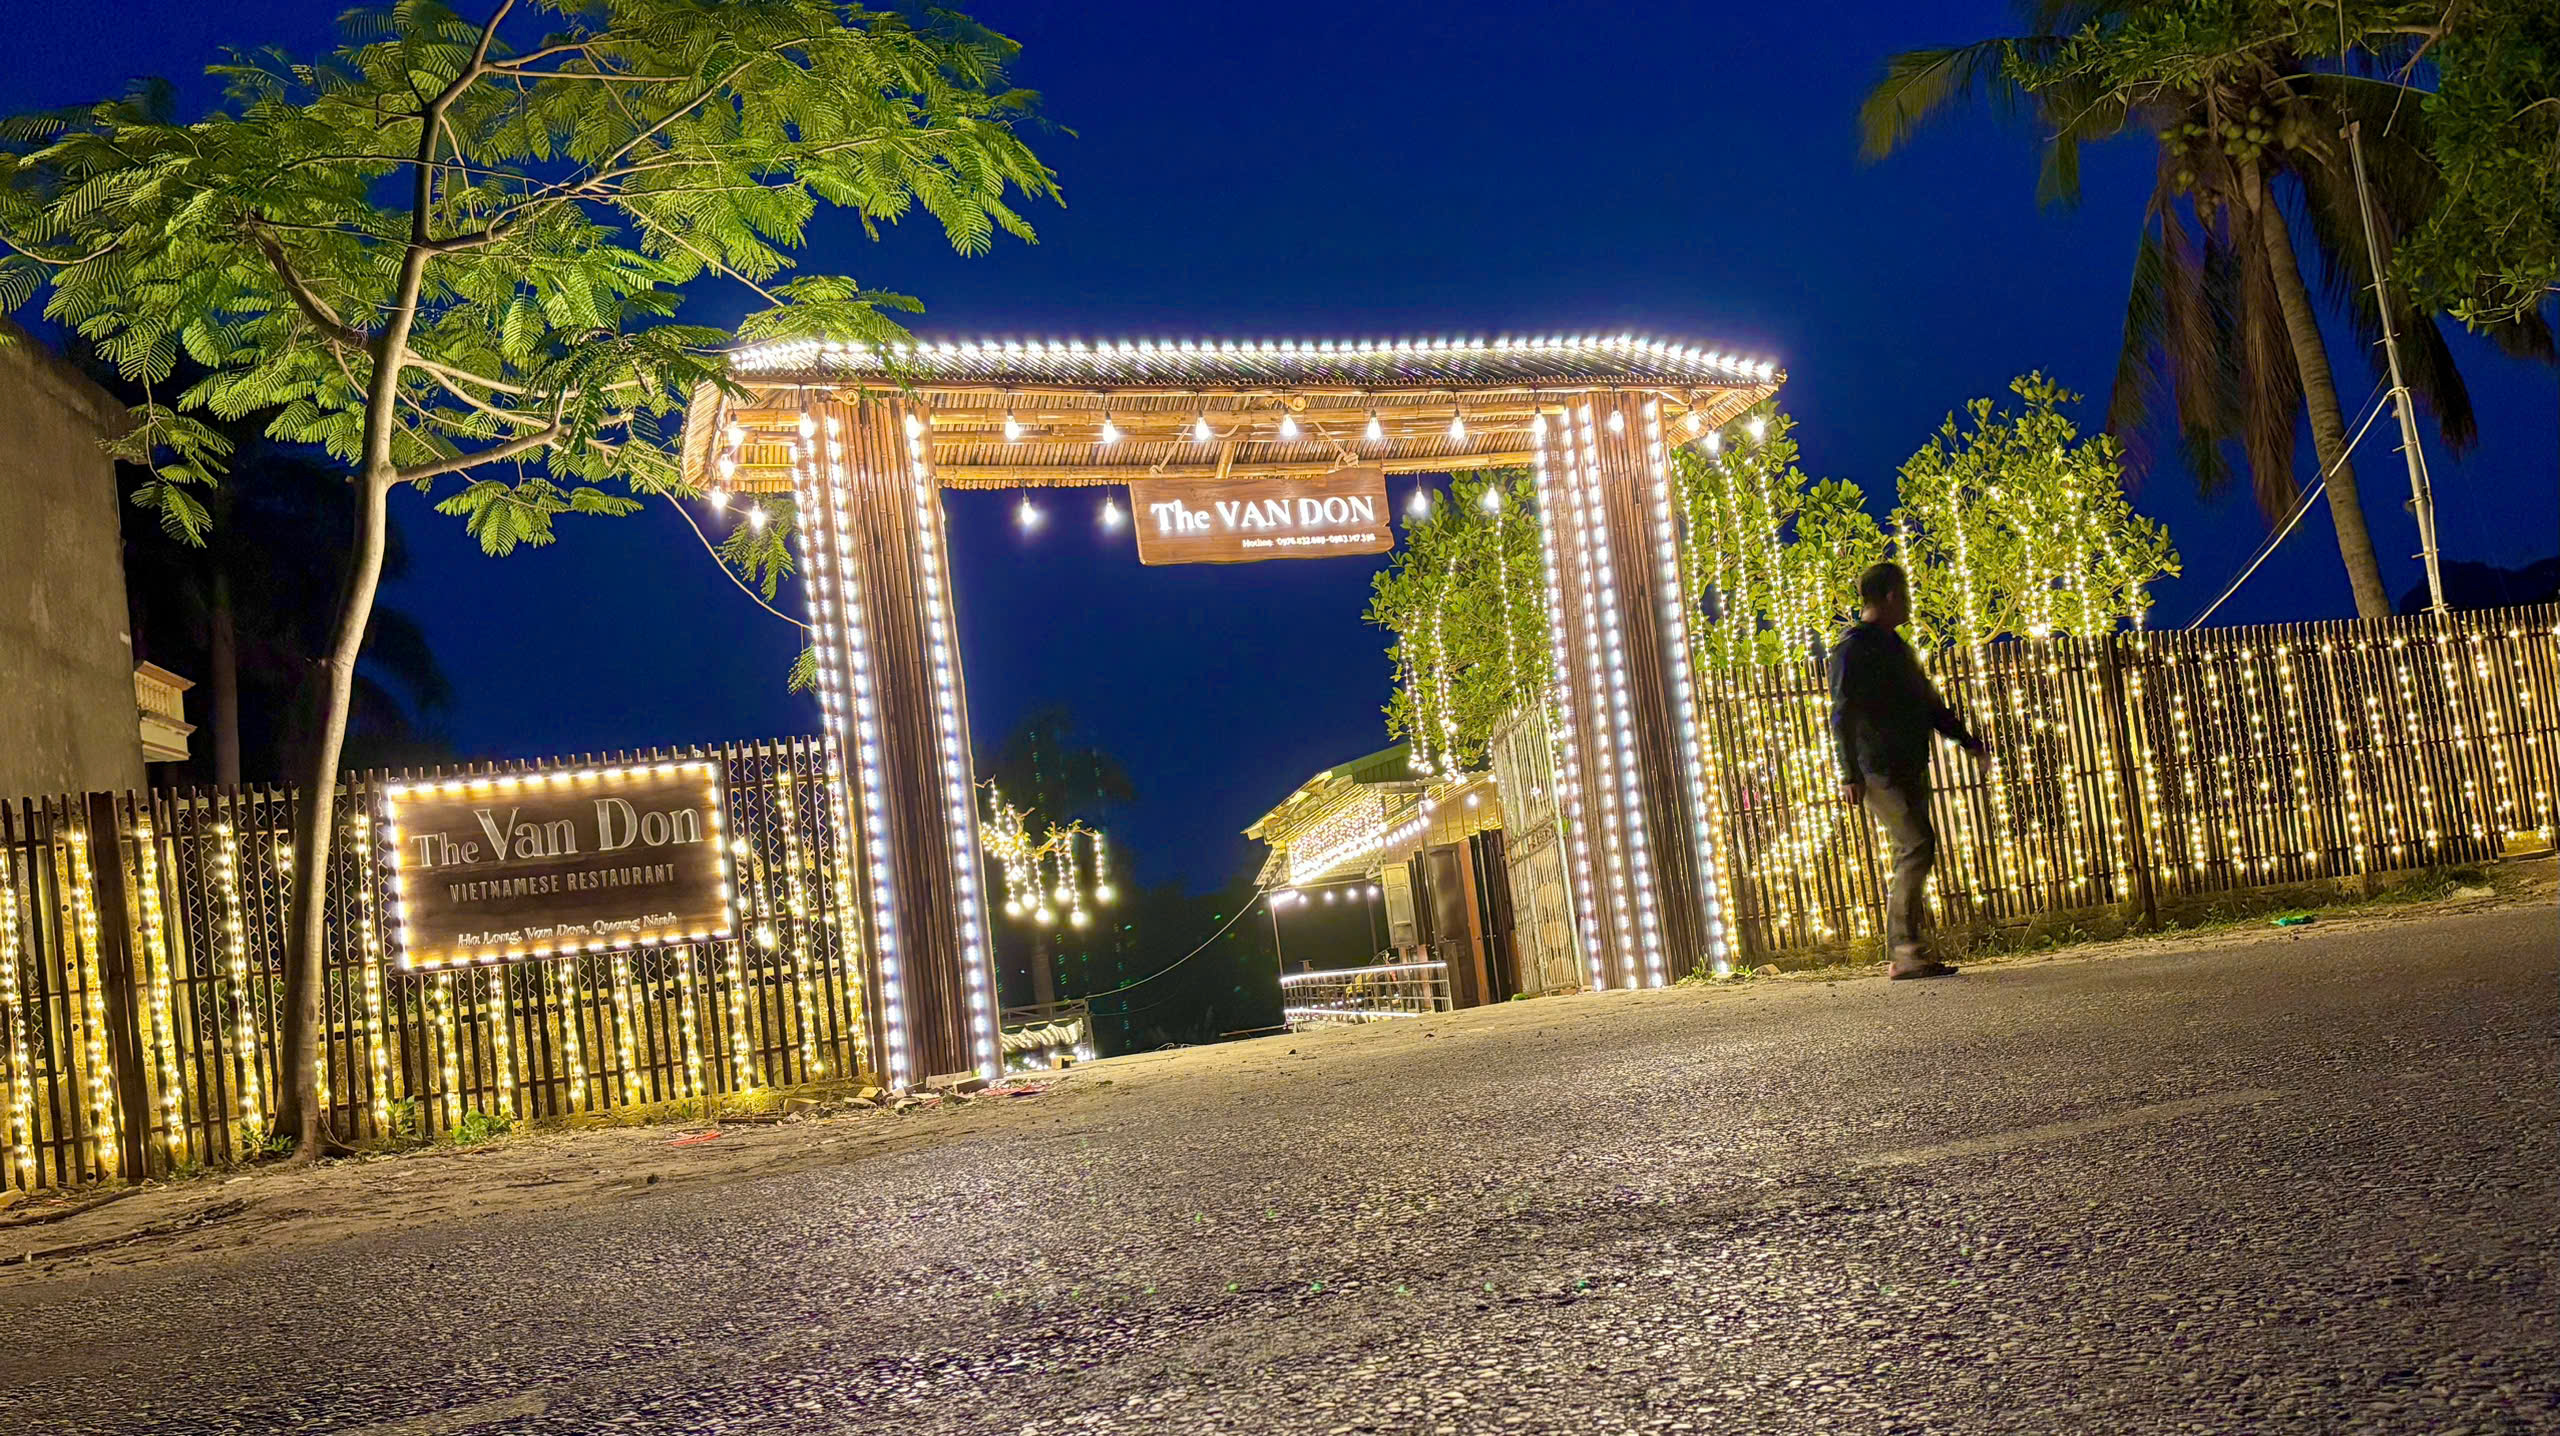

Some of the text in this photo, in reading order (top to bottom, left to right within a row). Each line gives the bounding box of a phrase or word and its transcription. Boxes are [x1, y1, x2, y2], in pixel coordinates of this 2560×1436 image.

[1151, 495, 1376, 531] The VAN DON
[410, 797, 704, 867] The Van Don
[450, 863, 674, 903] VIETNAMESE RESTAURANT
[457, 933, 481, 948] Ha
[483, 931, 523, 945] Long,
[524, 926, 553, 941] Van
[592, 918, 641, 936] Quang
[643, 911, 678, 928] Ninh
